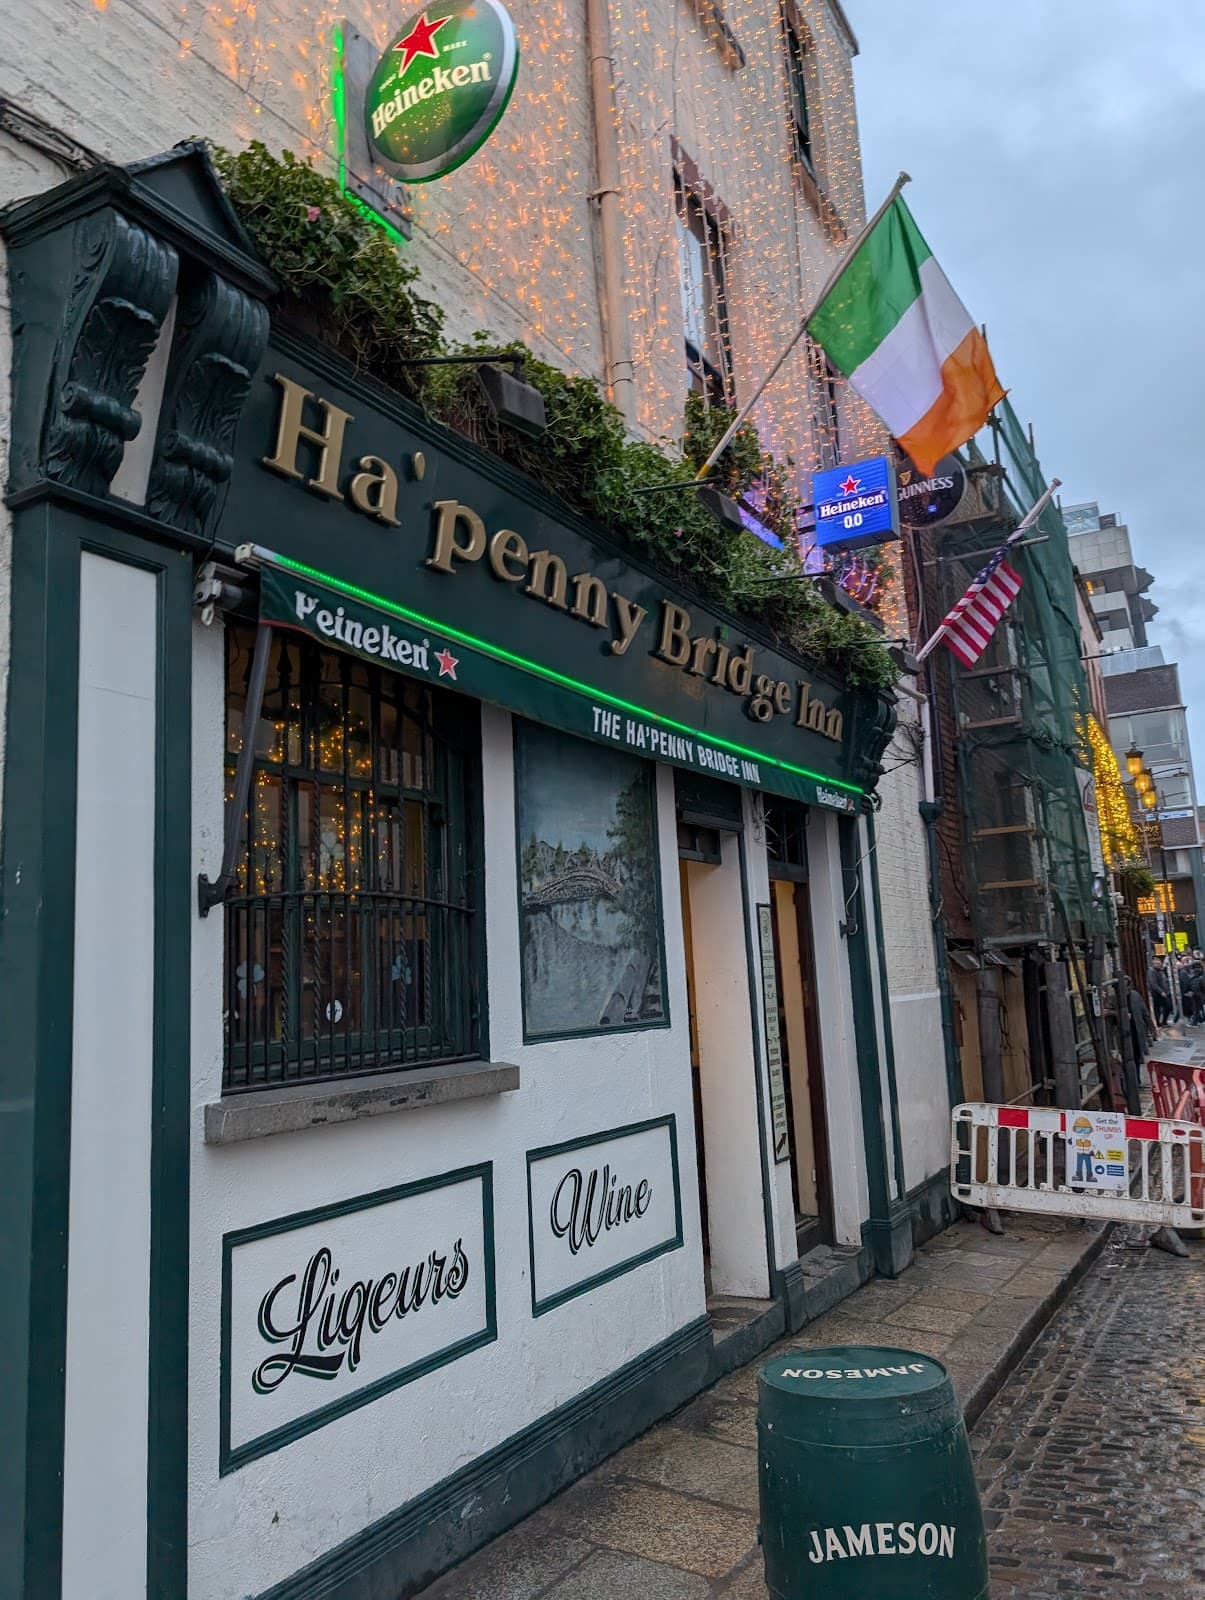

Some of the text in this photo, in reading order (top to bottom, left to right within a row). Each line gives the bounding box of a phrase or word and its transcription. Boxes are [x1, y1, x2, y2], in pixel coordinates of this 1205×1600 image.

[371, 60, 492, 139] Heineken
[820, 492, 885, 518] Heineken
[660, 599, 791, 722] Bridge
[797, 680, 843, 742] Inn
[592, 706, 761, 784] THE HA'PENNY BRIDGE INN
[1096, 1117, 1107, 1125] Get
[550, 1164, 652, 1254] Wine
[781, 1363, 925, 1379] JAMESON
[808, 1522, 956, 1564] JAMESON
